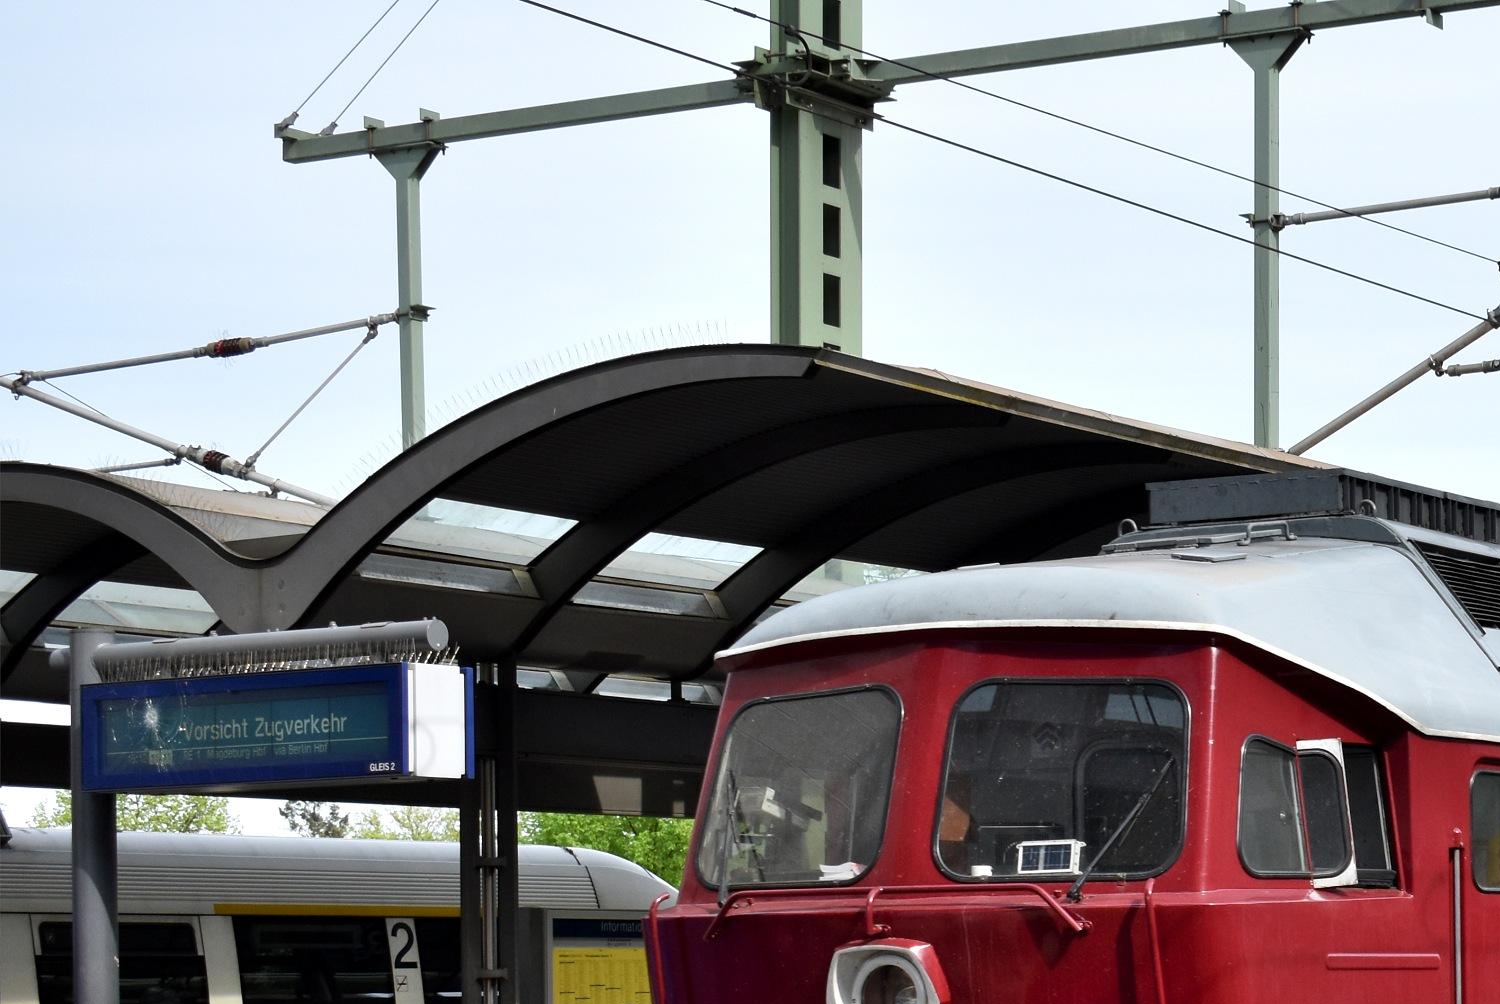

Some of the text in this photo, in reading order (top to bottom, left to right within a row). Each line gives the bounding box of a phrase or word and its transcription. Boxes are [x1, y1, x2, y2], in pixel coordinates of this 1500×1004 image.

[184, 713, 347, 742] Vorsicht Zugverkehr
[288, 744, 311, 755] Berlin
[314, 742, 328, 753] Hbf
[369, 762, 395, 771] GLEIS 2
[391, 922, 418, 968] 2
